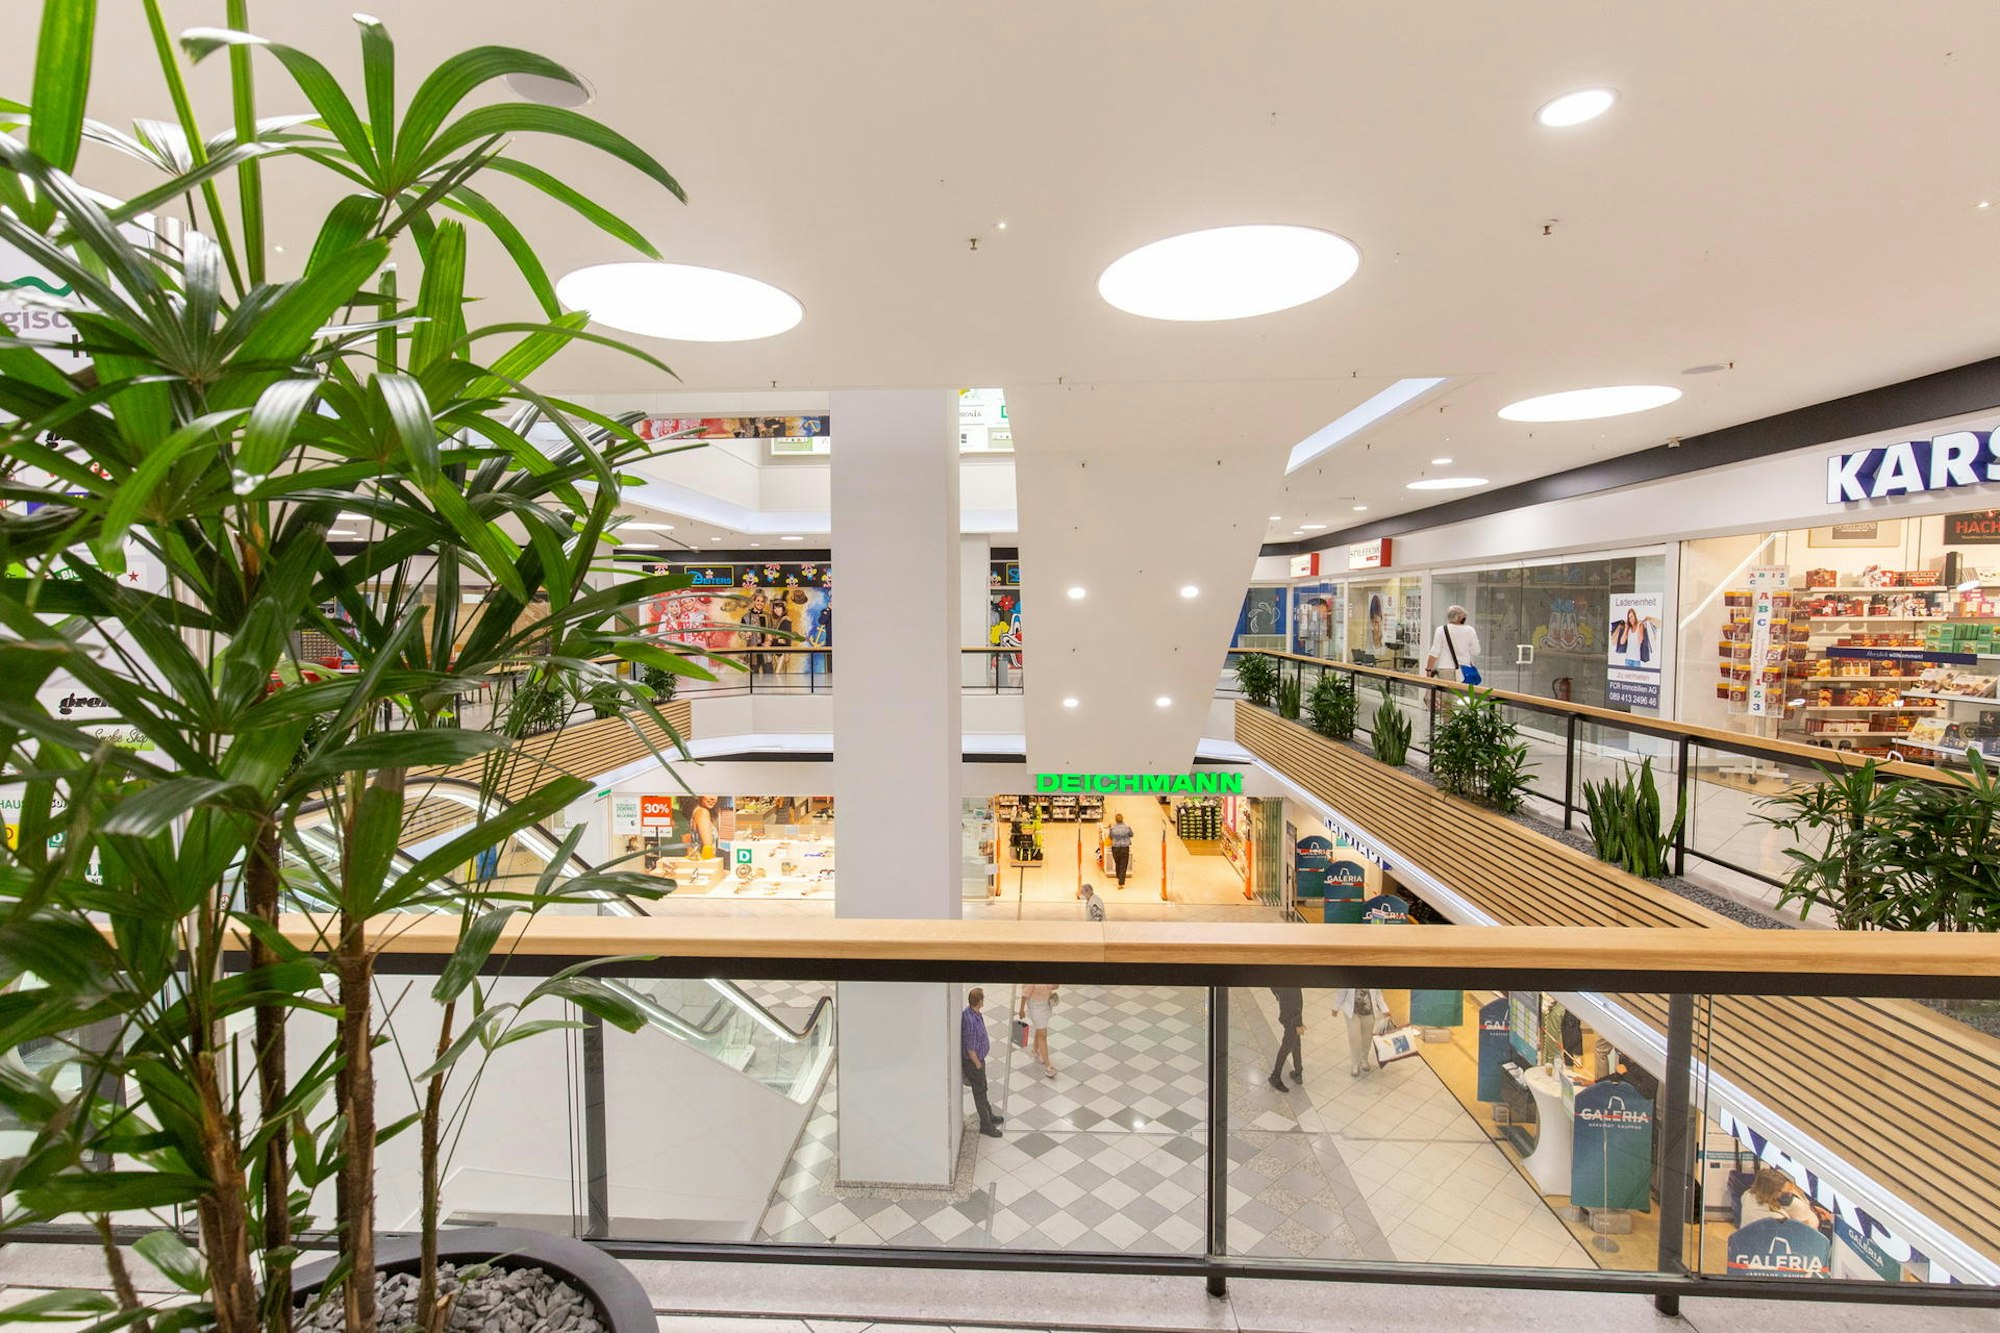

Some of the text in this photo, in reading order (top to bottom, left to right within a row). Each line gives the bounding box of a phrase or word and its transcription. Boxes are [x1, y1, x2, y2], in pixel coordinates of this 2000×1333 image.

[1826, 425, 2000, 504] KAR
[1616, 597, 1657, 606] Ladeneinheit
[1758, 605, 1768, 613] B
[1757, 619, 1766, 627] C
[1649, 686, 1658, 695] AG
[1753, 690, 1761, 698] 2
[1753, 703, 1760, 711] 3
[1036, 772, 1244, 794] DEICHMANN
[644, 803, 670, 813] 30%
[1327, 875, 1363, 883] GALERIA
[1581, 1108, 1650, 1123] GALERIA
[1735, 1254, 1823, 1272] GALERIA
